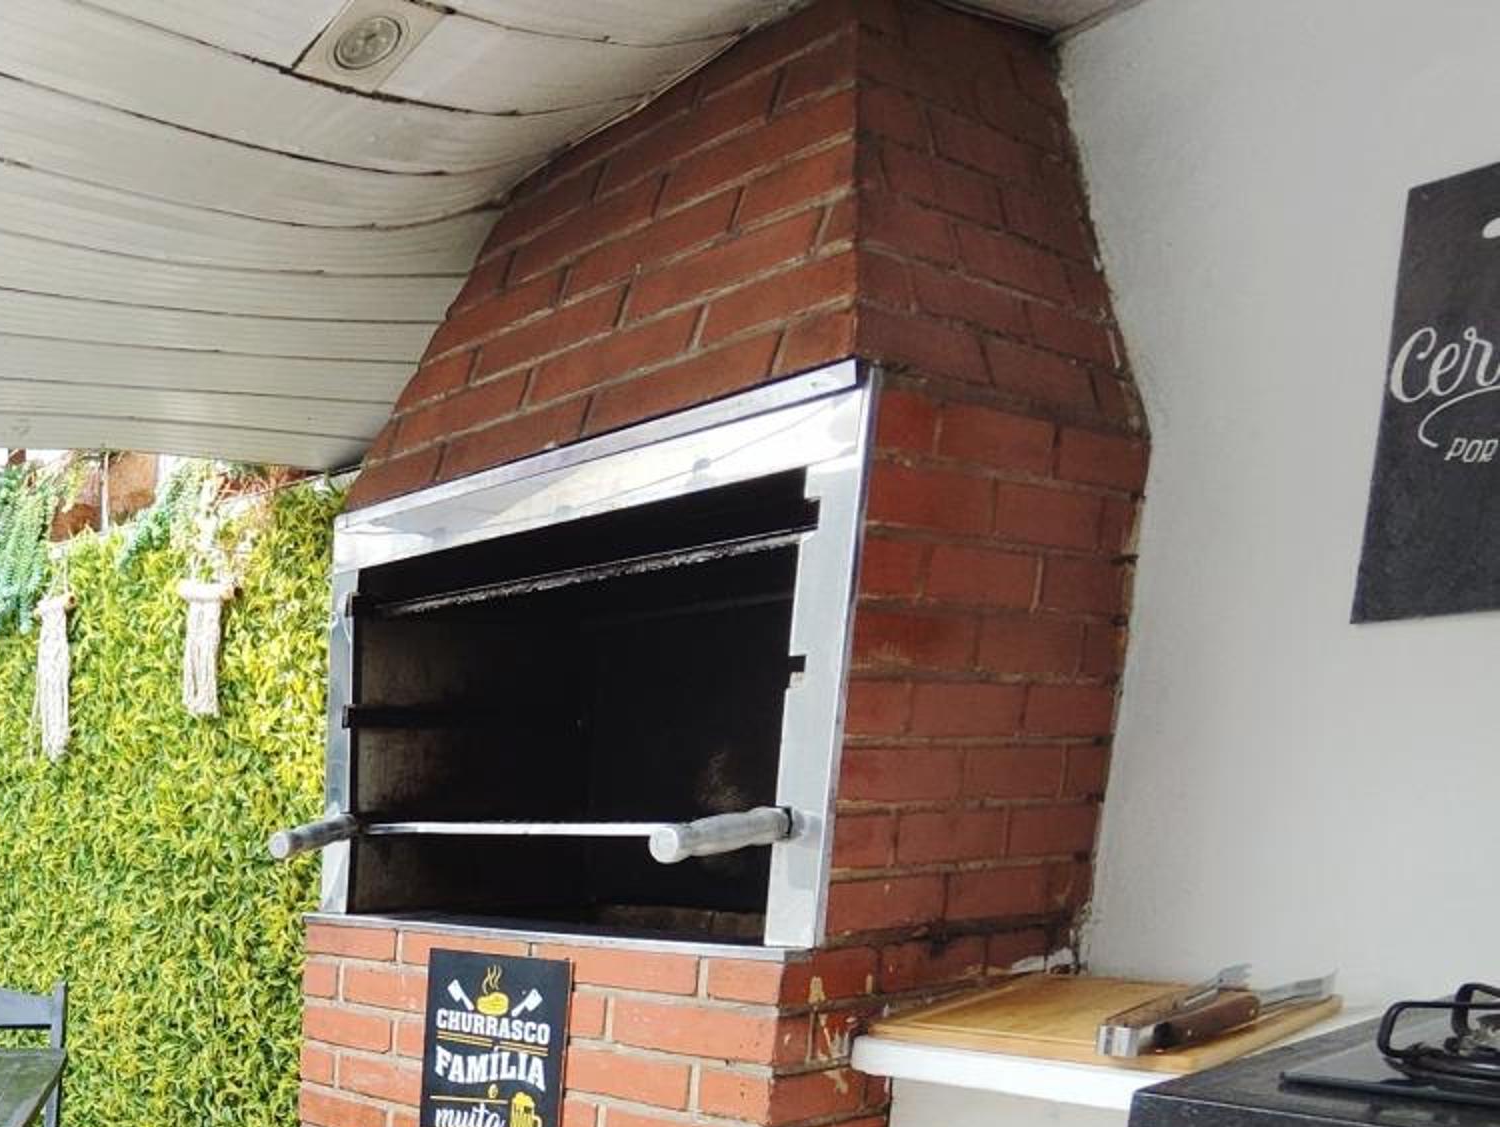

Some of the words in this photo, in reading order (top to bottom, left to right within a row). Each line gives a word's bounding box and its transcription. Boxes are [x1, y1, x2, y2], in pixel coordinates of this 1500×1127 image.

[1390, 327, 1500, 402] Cer
[436, 1008, 551, 1045] CHURRASCO
[435, 1045, 546, 1092] FAMÍLIA
